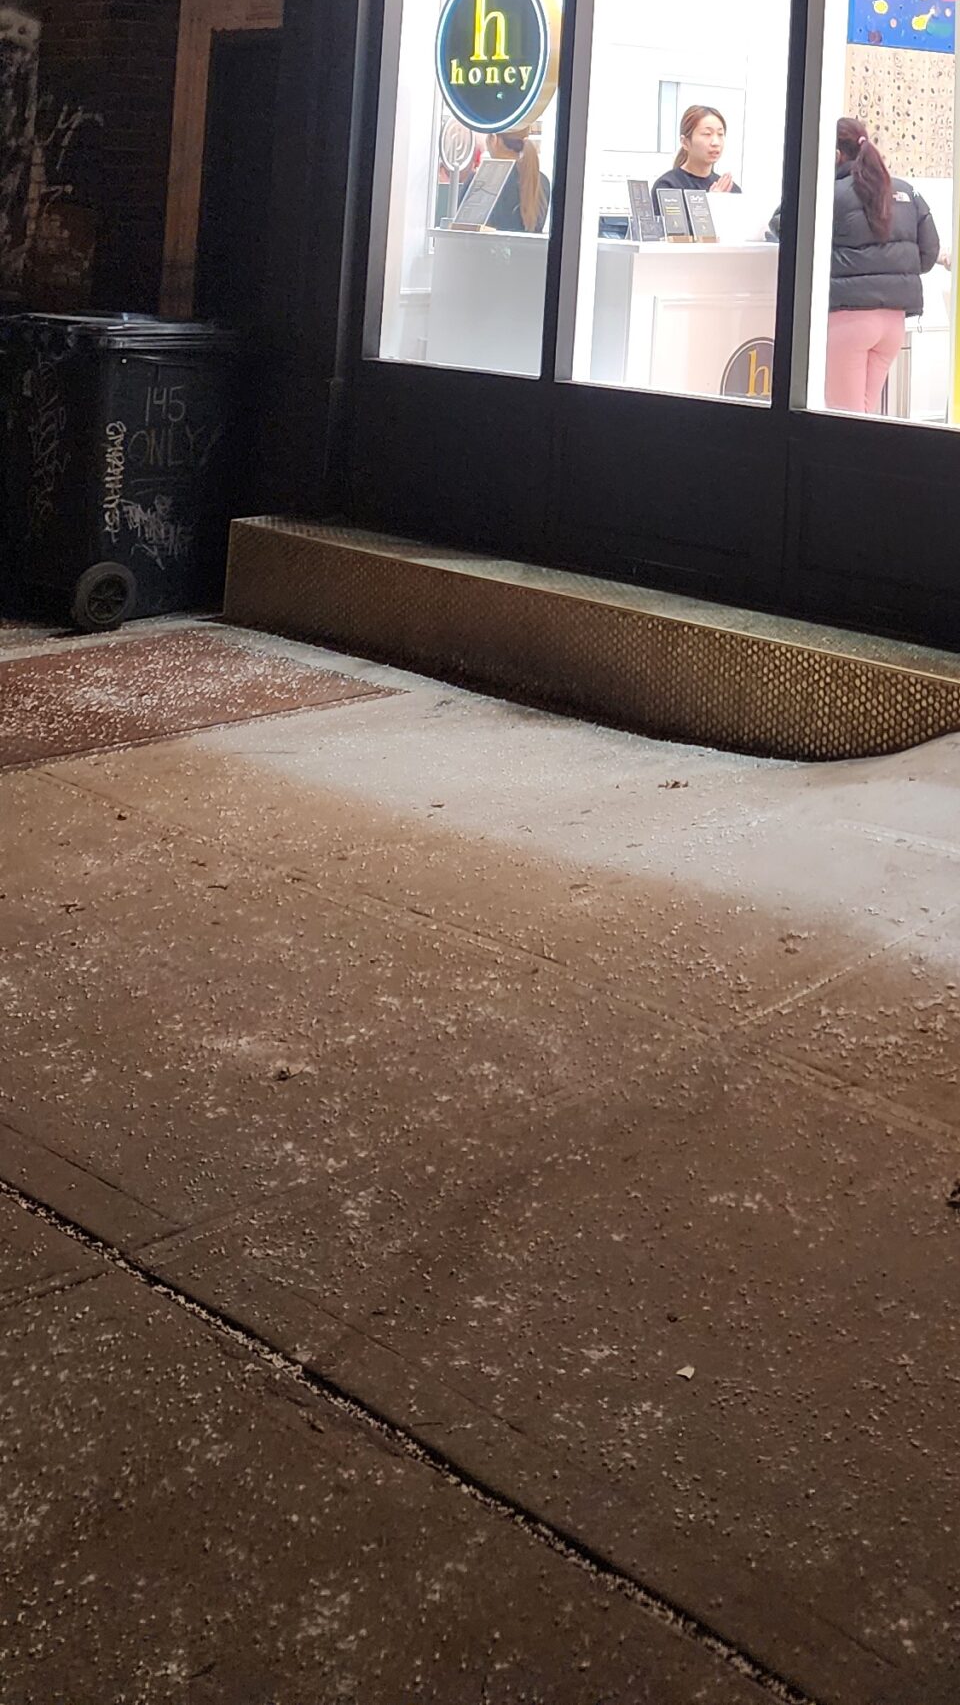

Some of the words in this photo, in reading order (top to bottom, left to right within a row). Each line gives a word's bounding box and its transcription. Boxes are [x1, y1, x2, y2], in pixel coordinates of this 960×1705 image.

[449, 59, 533, 91] honey
[745, 348, 771, 397] h
[146, 385, 186, 426] 145
